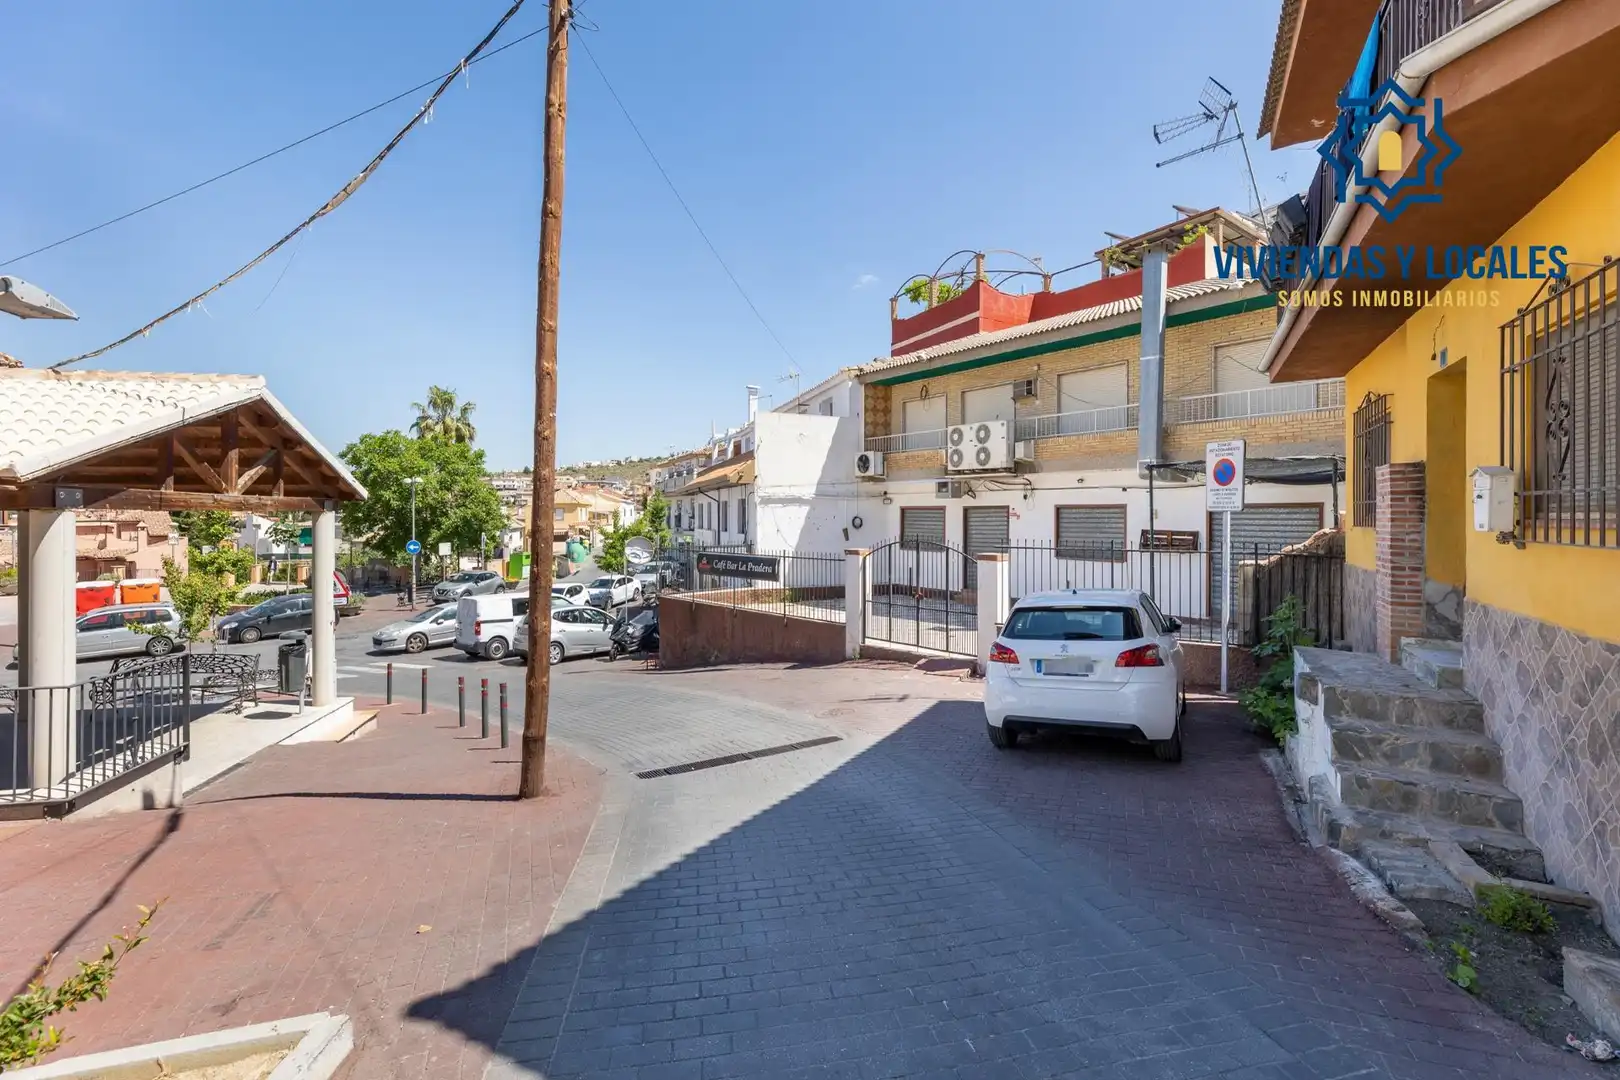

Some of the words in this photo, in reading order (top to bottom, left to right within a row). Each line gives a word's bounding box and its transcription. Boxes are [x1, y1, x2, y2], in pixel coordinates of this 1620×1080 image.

[713, 559, 726, 571] Café
[726, 560, 738, 570] Bar
[738, 561, 747, 571] La
[747, 562, 773, 573] Pradera
